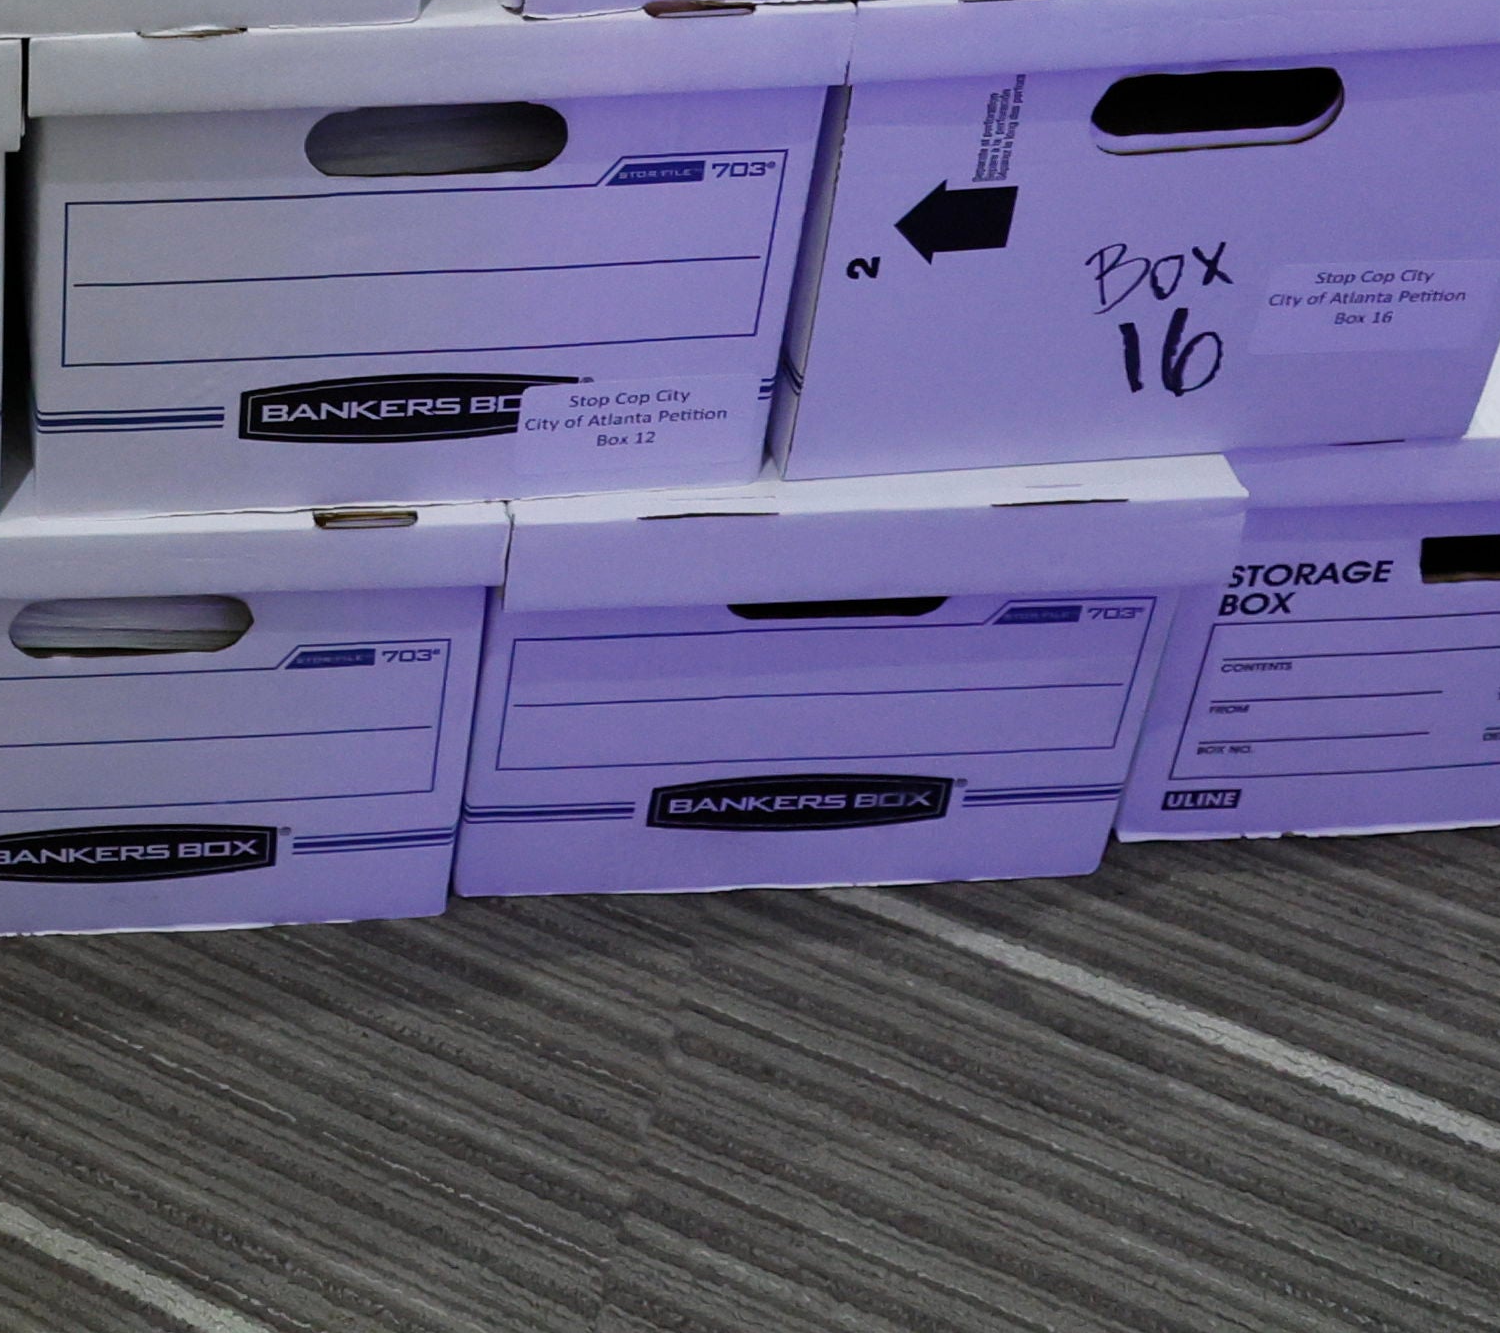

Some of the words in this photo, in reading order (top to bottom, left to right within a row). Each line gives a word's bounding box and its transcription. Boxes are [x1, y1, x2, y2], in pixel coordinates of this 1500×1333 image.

[846, 256, 881, 280] 2
[1315, 271, 1357, 286] Stop
[1360, 270, 1396, 285] Cop
[1400, 269, 1435, 284] City
[1268, 293, 1303, 308] City
[1306, 291, 1328, 306] of
[1329, 291, 1393, 305] Atlanta
[1398, 290, 1466, 303] Petition
[1333, 312, 1365, 325] Box
[1372, 310, 1393, 324] 16
[1118, 307, 1223, 398] 16
[261, 397, 461, 423] BANKERS
[469, 394, 524, 418] BO
[569, 395, 611, 408] Stop
[614, 392, 651, 406] Cop
[655, 389, 691, 404] City
[524, 418, 560, 432] City
[564, 414, 584, 429] of
[587, 412, 652, 427] Atlanta
[658, 409, 728, 422] Petition
[596, 434, 628, 447] Box
[635, 430, 656, 445] 12
[1228, 560, 1394, 589] STORAGE
[1217, 591, 1295, 617] BOX
[1220, 658, 1293, 674] CONTENTS
[668, 794, 847, 814] BANKERS
[853, 791, 931, 809] BOX
[1165, 789, 1238, 809] ULINE
[178, 839, 257, 858] BOX
